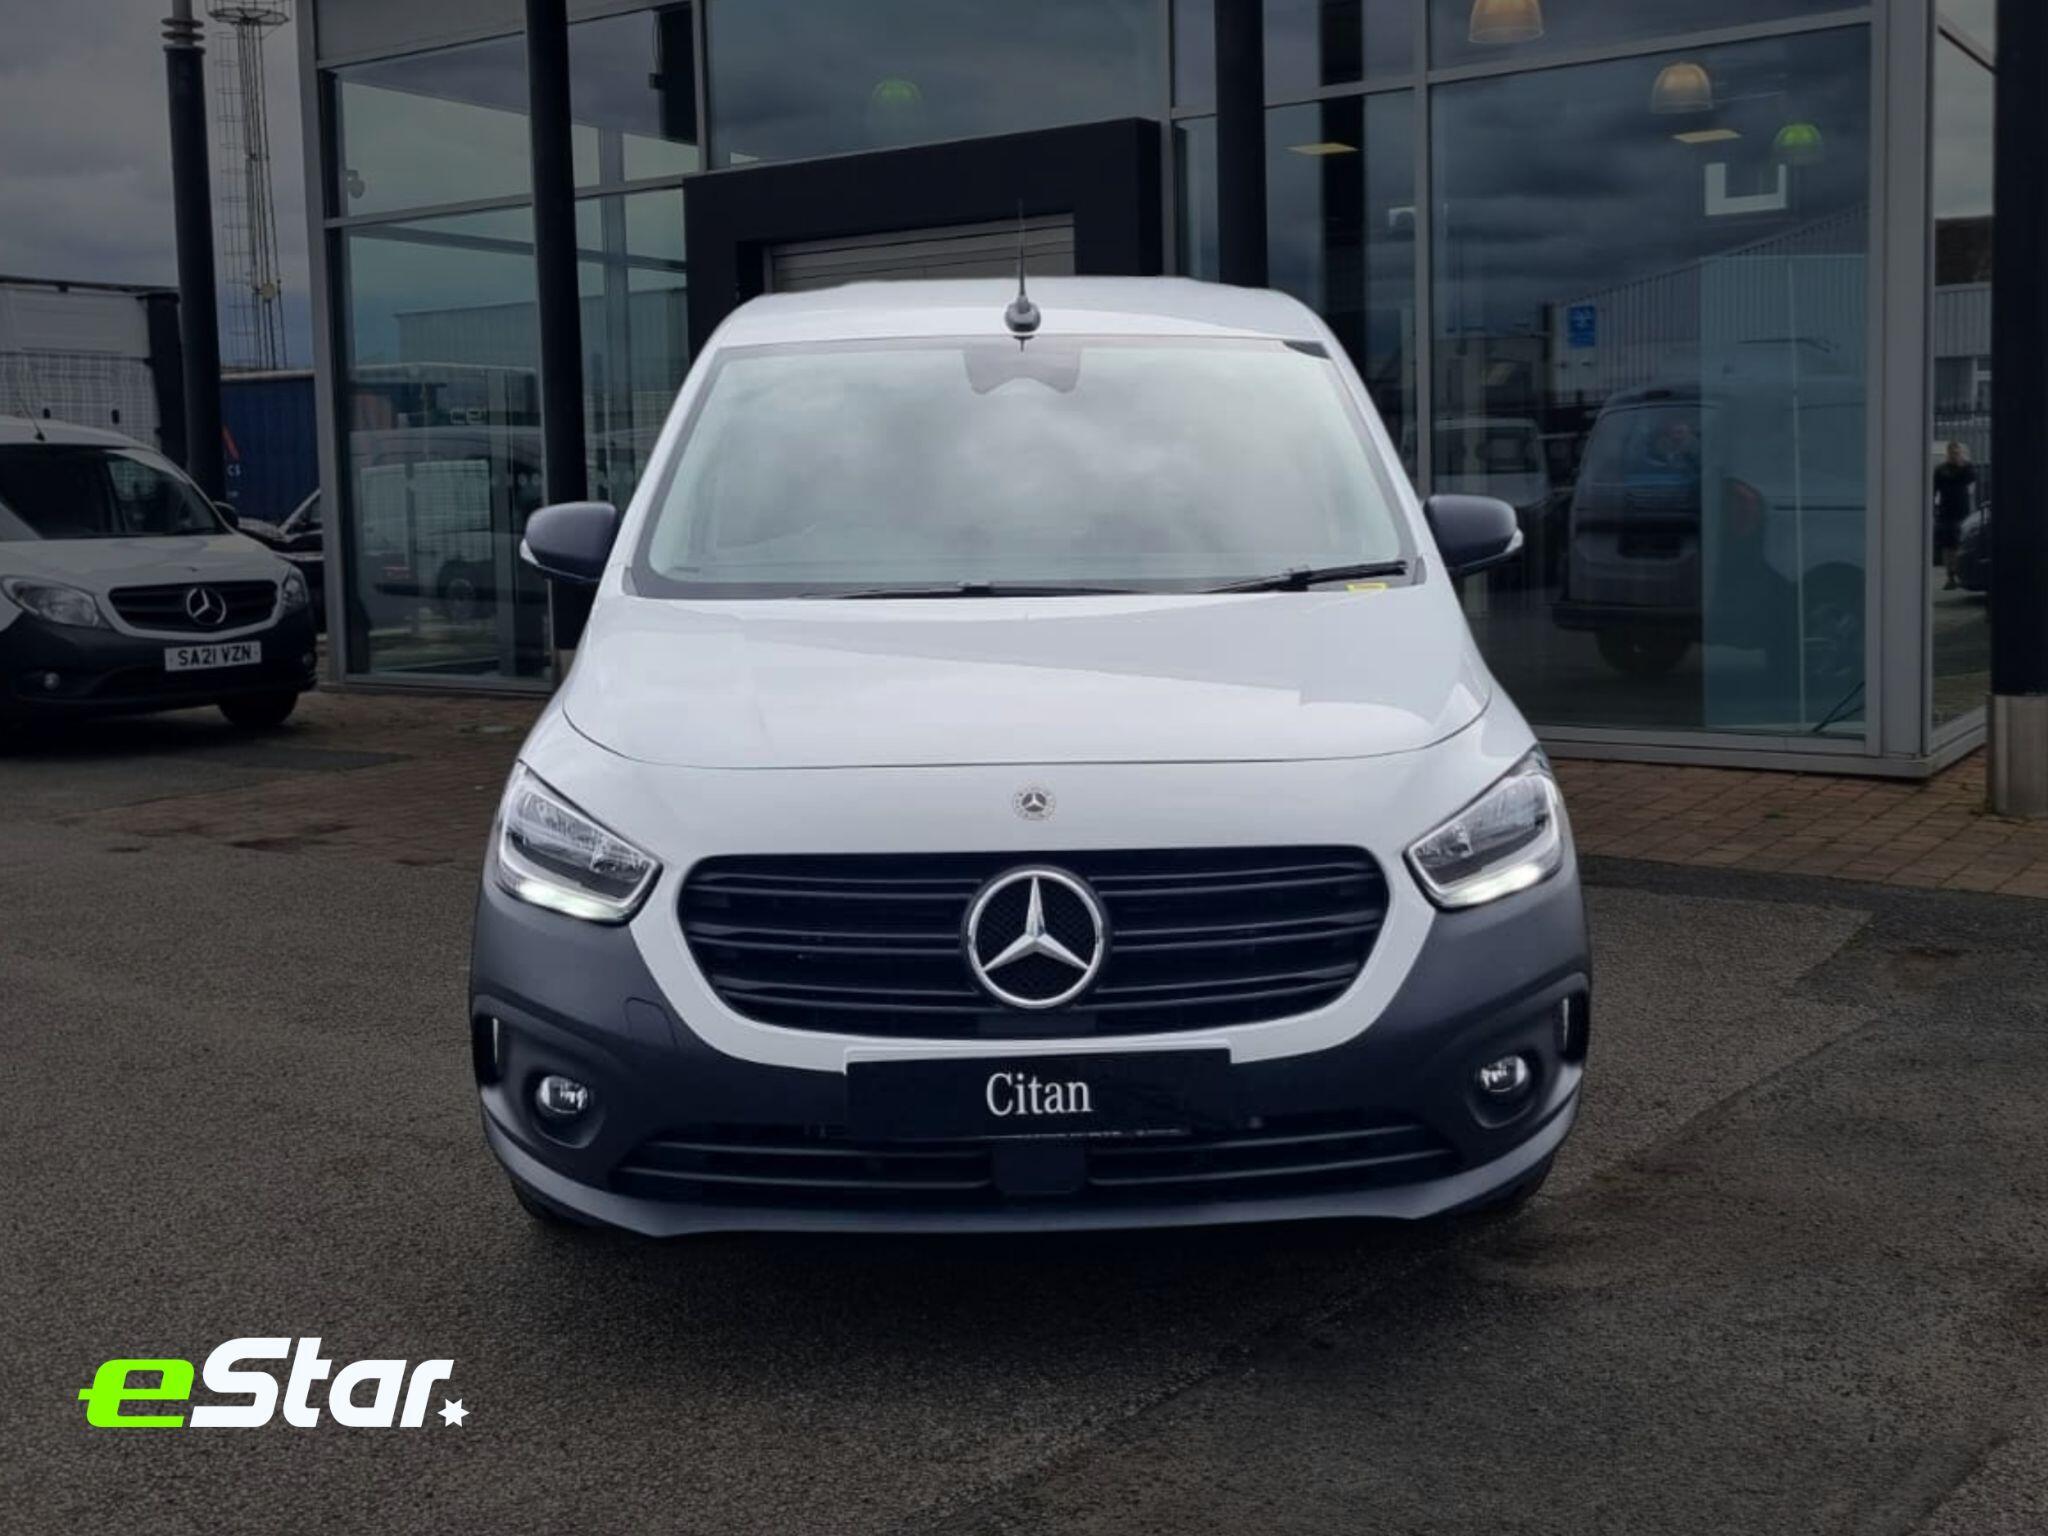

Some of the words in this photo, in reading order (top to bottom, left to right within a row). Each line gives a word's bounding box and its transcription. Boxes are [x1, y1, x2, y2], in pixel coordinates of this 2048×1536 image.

[177, 648, 217, 667] SA21
[221, 644, 252, 664] VZN
[985, 1072, 1092, 1117] Citan
